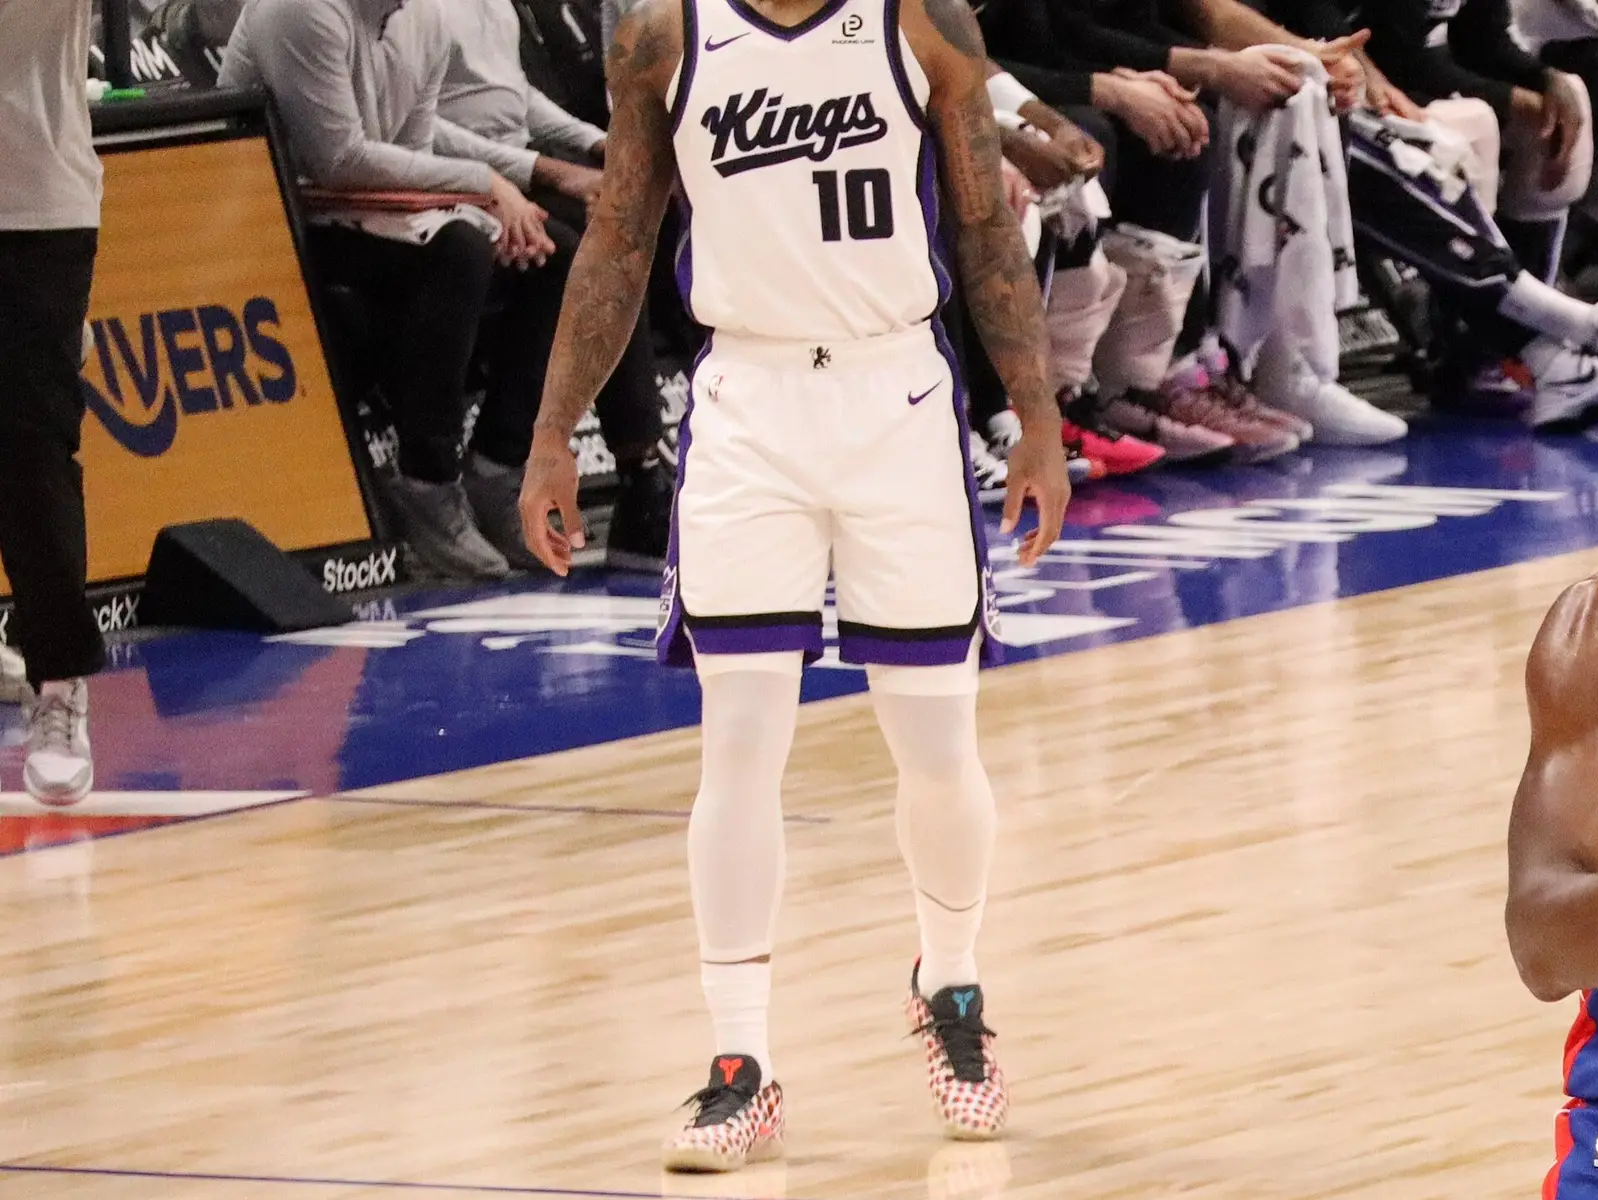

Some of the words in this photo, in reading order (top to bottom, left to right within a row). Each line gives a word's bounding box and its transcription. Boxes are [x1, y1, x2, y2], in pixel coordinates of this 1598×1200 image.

[701, 87, 888, 178] Kings
[812, 168, 894, 242] 10
[323, 546, 397, 593] StockX
